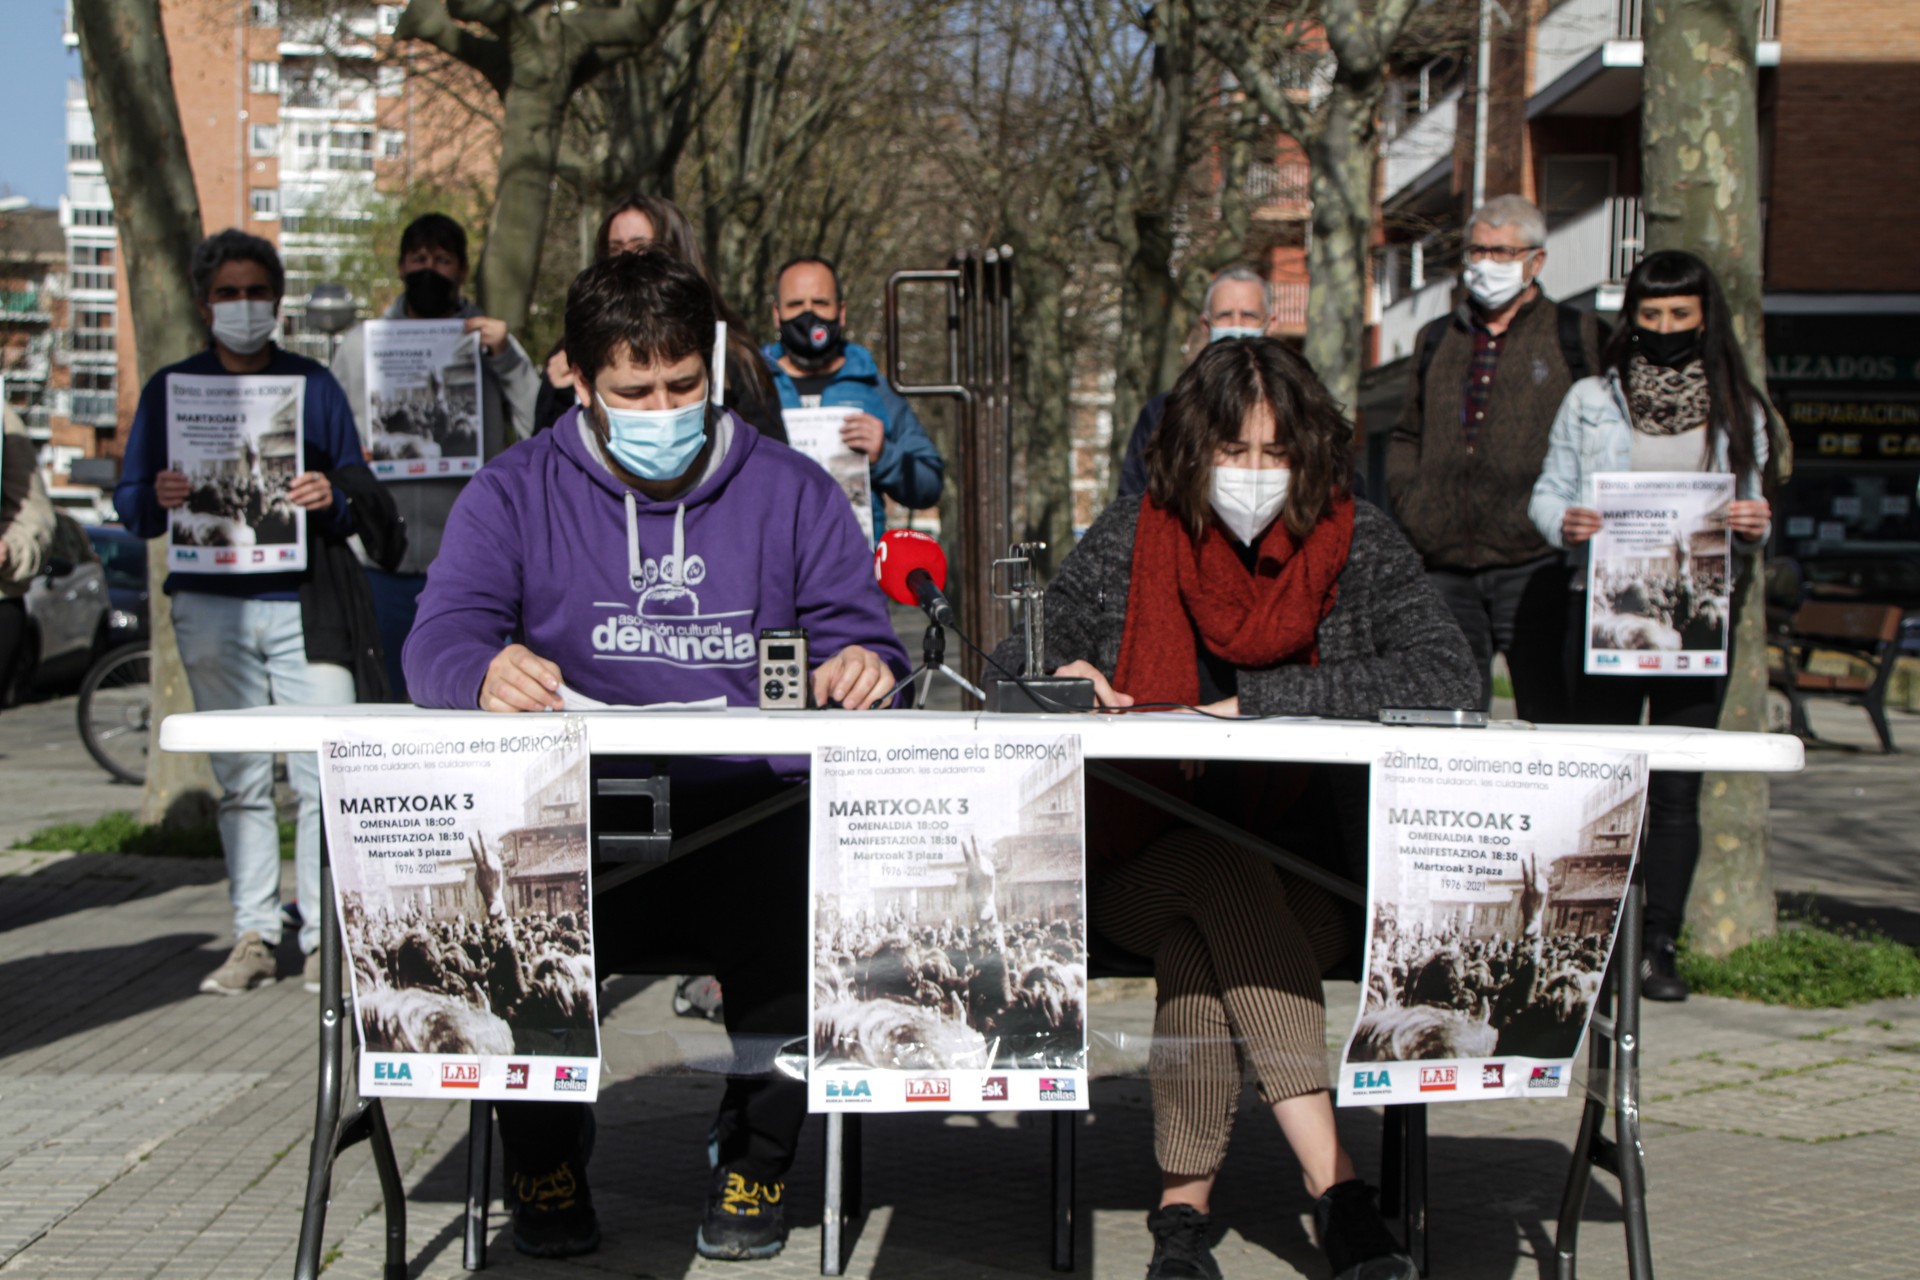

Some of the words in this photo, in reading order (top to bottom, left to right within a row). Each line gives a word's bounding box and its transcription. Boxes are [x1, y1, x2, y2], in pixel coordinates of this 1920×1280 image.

[1766, 354, 1897, 381] ALZADOS
[1817, 432, 1863, 456] DE
[676, 622, 722, 637] cultural
[592, 617, 757, 661] denuncia
[330, 741, 386, 759] Zaintza,
[392, 738, 465, 756] oroimena
[470, 739, 495, 754] eta
[824, 746, 881, 763] Zaintza,
[887, 746, 959, 762] oroimena
[964, 745, 990, 760] eta
[995, 744, 1067, 761] BORROKA
[332, 764, 361, 773] Porque
[363, 764, 378, 772] nos
[824, 767, 855, 778] Porque
[857, 768, 872, 776] nos
[1384, 752, 1443, 772] Zaintza,
[1449, 756, 1522, 775] oroimena
[1528, 759, 1553, 776] eta
[1558, 762, 1633, 782] BORROKA
[1384, 773, 1416, 785] Porque
[1418, 776, 1434, 785] nos
[340, 794, 458, 814] MARTXOAK
[463, 794, 474, 810] 3
[829, 798, 952, 818] MARTXOAK
[957, 798, 970, 815] 3
[360, 818, 420, 829] OMENALDIA
[425, 818, 456, 826] 18:00
[848, 822, 912, 832] OMENALDIA
[918, 820, 950, 830] 18:00
[1388, 808, 1514, 830] MARTXOAK
[1519, 814, 1531, 832] 3
[354, 833, 434, 844] MANIFESTAZIOA
[439, 832, 464, 842] 18:30
[840, 836, 926, 846] MANIFESTAZIOA
[931, 836, 957, 846] 18:30
[1408, 832, 1474, 844] OMENALDIA
[1478, 834, 1510, 846] 18:00
[368, 848, 416, 858] Martxoak
[417, 848, 424, 858] 3
[425, 848, 452, 859] plaza
[854, 851, 906, 861] Martxoak
[907, 852, 914, 860] 3
[915, 851, 943, 862] plaza
[1399, 846, 1487, 860] MANIFESTAZIOA
[1492, 850, 1518, 862] 18:30
[395, 864, 414, 874] 1976
[882, 866, 901, 877] 1976
[1414, 861, 1466, 874] Martxoak
[1467, 864, 1474, 874] 3
[1475, 866, 1503, 878] plaza
[1440, 879, 1461, 890] 1976
[374, 1062, 412, 1080] ELA
[444, 1066, 478, 1080] LAB
[1422, 1069, 1455, 1084] LAB
[1353, 1070, 1392, 1088] ELA
[826, 1080, 872, 1096] ELA
[909, 1080, 948, 1094] LAB
